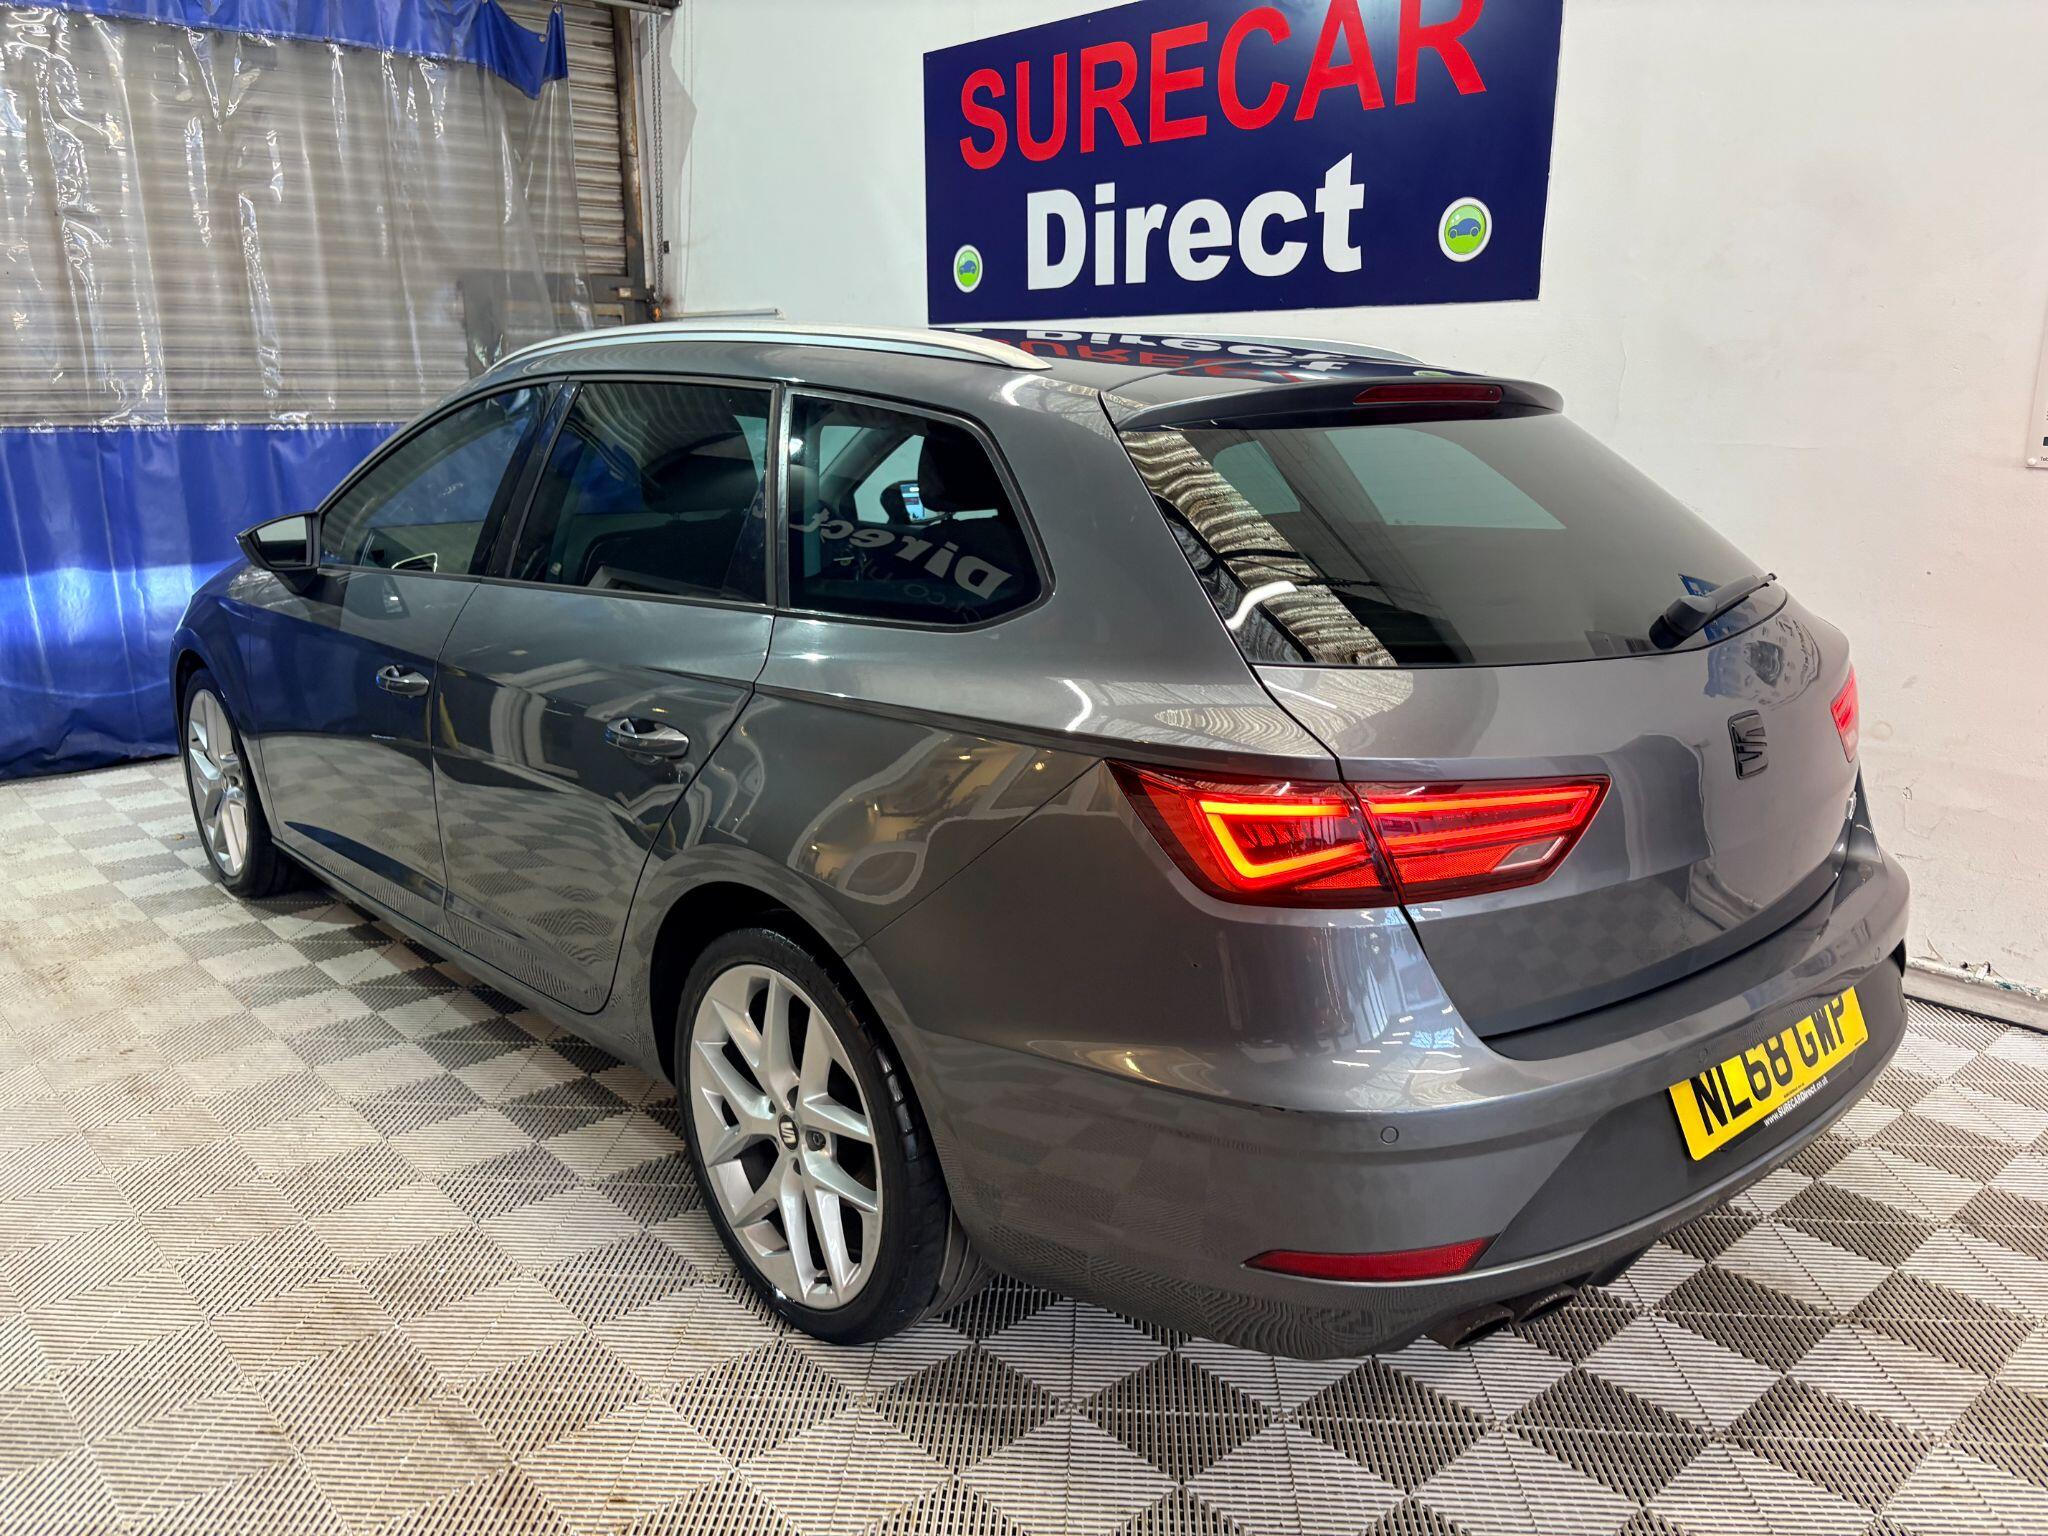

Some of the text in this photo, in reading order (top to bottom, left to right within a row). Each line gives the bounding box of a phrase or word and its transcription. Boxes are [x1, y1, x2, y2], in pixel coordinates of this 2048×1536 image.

[959, 0, 1487, 171] SURECAR
[1027, 152, 1364, 290] Direct
[1690, 994, 1845, 1137] NL68 GWP
